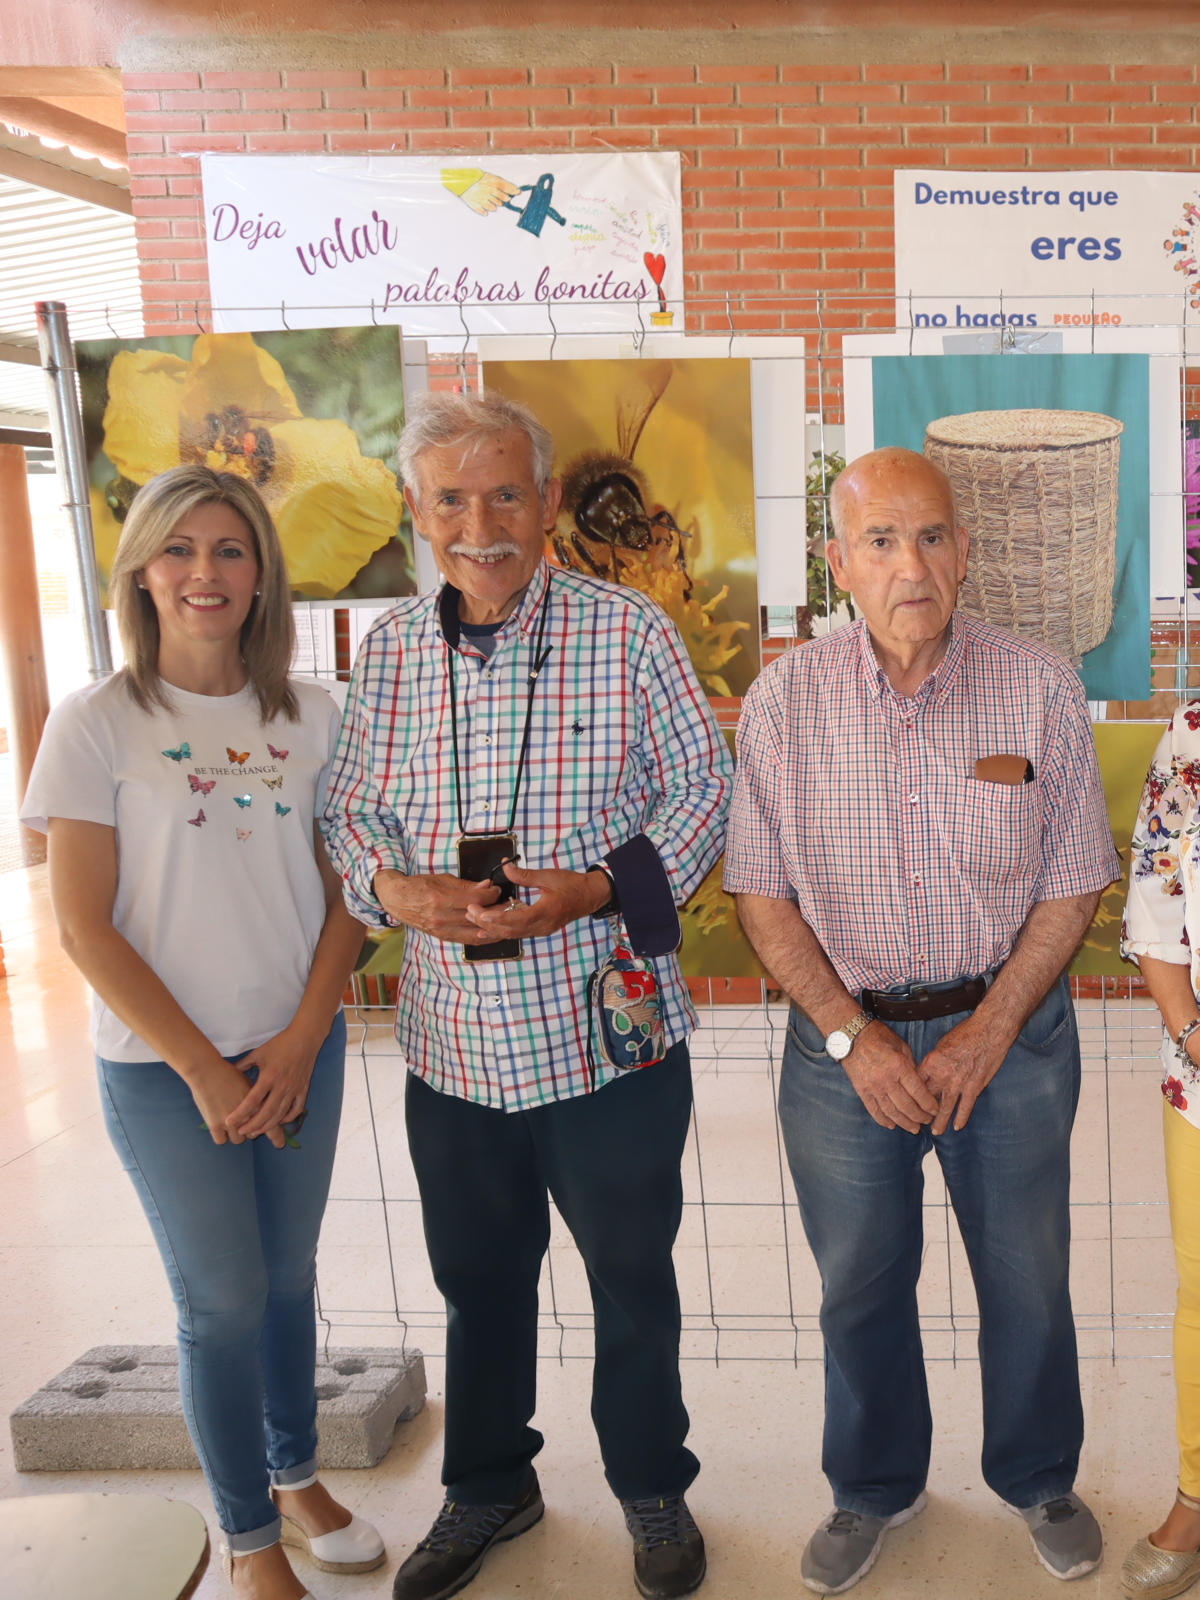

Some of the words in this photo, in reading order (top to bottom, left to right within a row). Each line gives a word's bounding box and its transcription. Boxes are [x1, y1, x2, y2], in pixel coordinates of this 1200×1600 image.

[914, 182, 1060, 206] Demuestra
[1068, 188, 1118, 212] que
[212, 203, 286, 252] Deja
[296, 210, 398, 276] volar
[1030, 235, 1122, 261] eres
[383, 266, 525, 312] palabras
[534, 265, 652, 302] bonitas
[915, 313, 947, 327] no
[1054, 312, 1122, 325] PEQUEÑO
[194, 767, 208, 775] BE
[208, 767, 231, 775] THE
[231, 765, 279, 776] CHANGE
